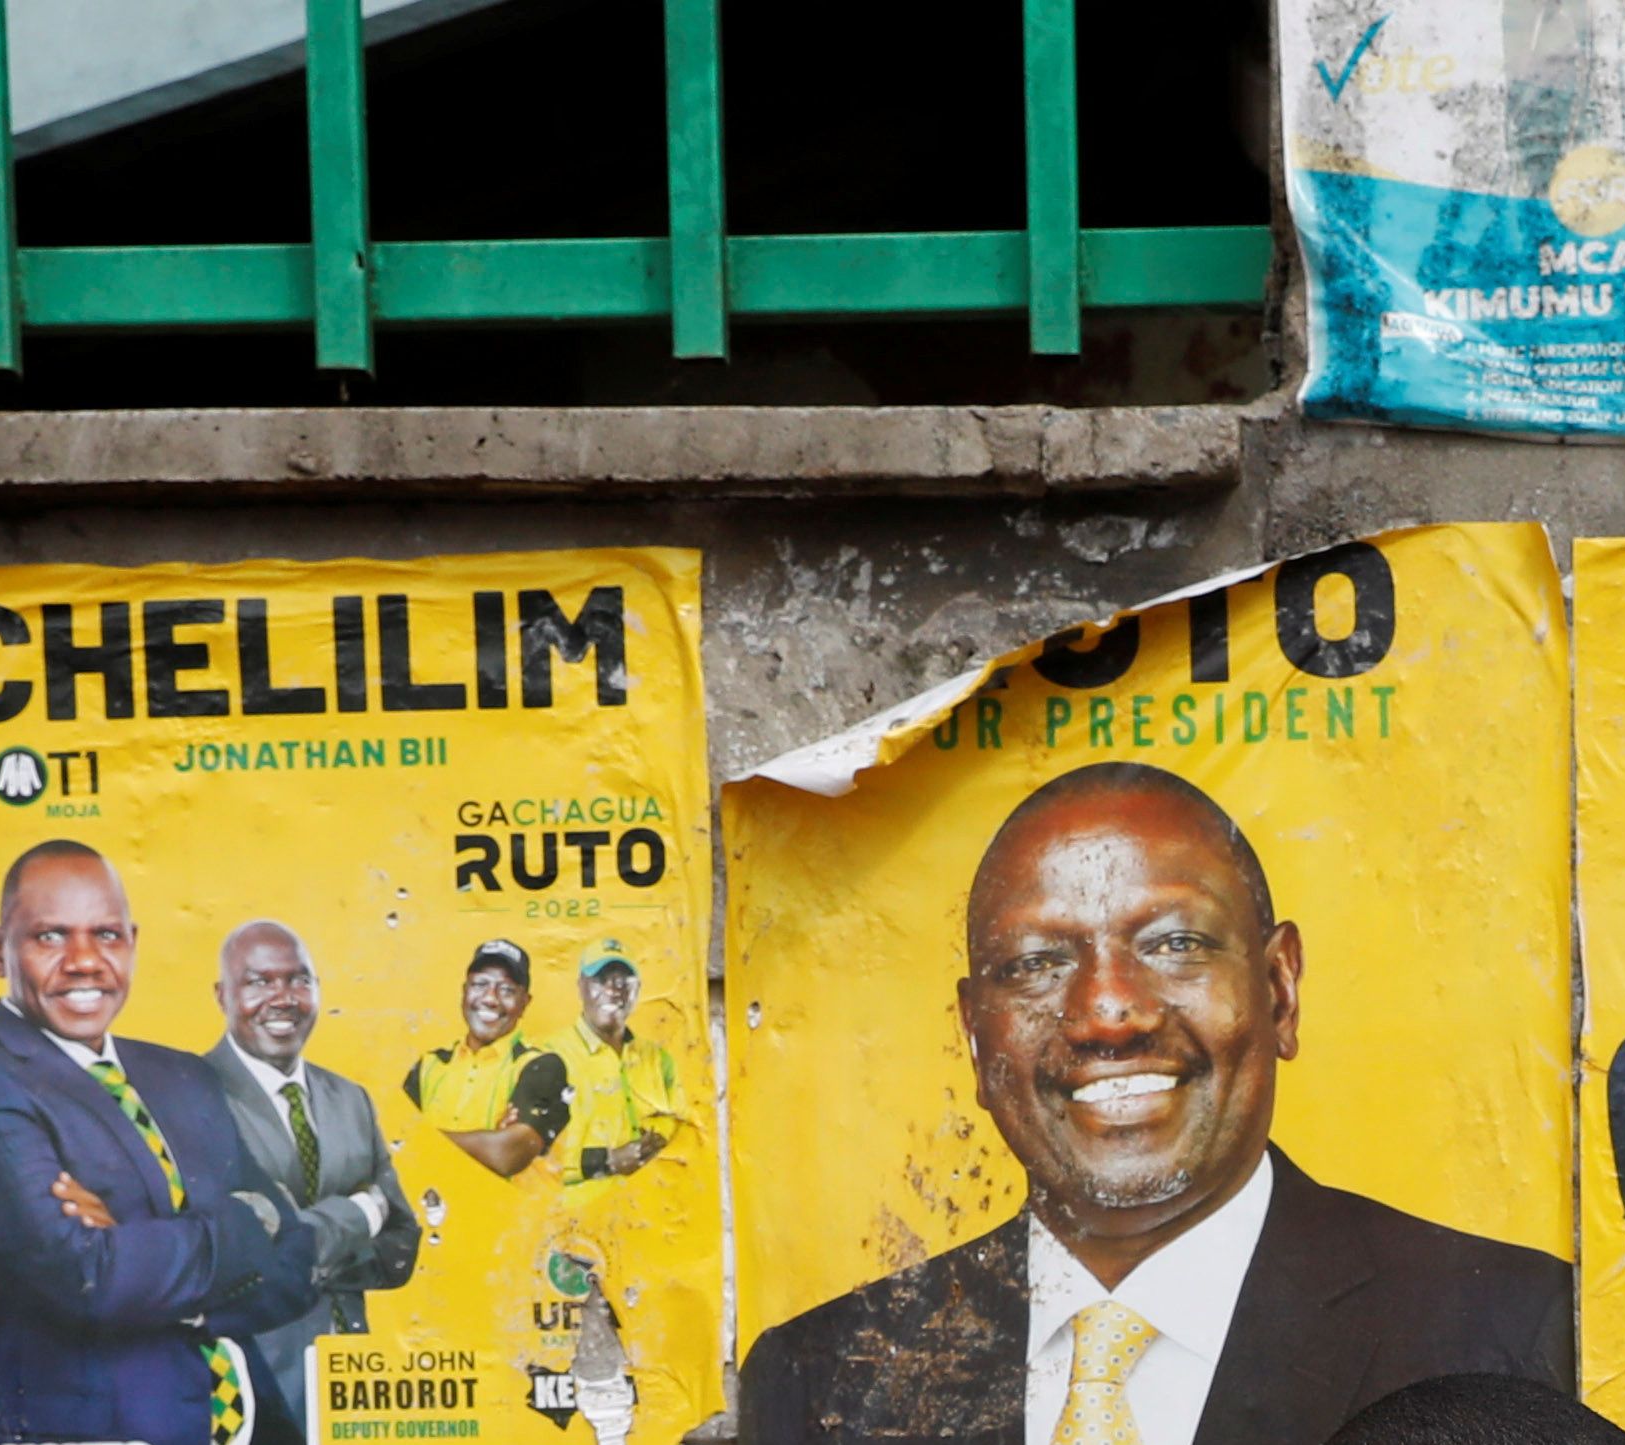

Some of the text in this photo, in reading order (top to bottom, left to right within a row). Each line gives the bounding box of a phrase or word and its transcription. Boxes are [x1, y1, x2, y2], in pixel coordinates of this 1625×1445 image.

[1424, 282, 1613, 321] KIMUMU
[1046, 686, 1396, 749] PRESIDENT
[174, 738, 448, 773] JONATHAN BII
[459, 796, 663, 827] GACHAGUA
[457, 829, 665, 892] RUTO
[401, 1351, 475, 1372] JOHN
[329, 1379, 477, 1410] BAROROT
[331, 1419, 479, 1441] DEPUTY GOVERNOR
